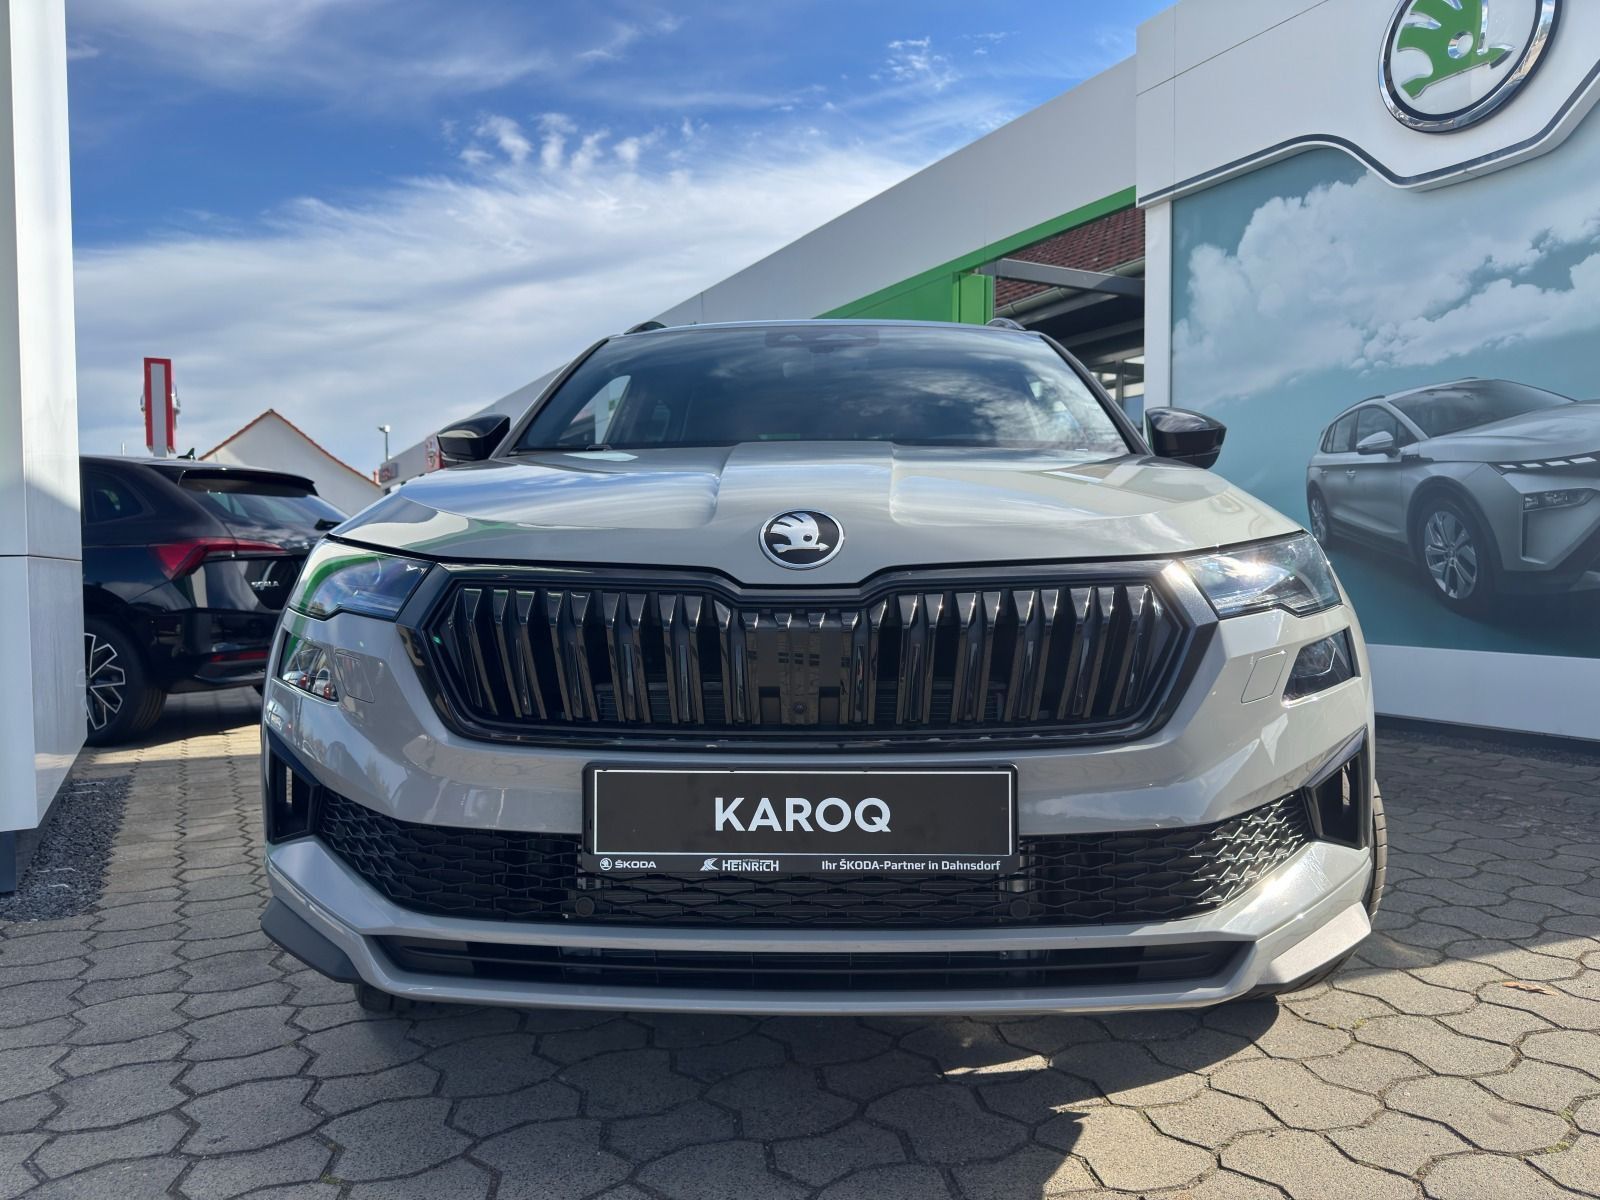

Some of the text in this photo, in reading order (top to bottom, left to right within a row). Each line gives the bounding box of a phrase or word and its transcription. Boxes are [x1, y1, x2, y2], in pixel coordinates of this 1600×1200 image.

[714, 796, 892, 833] KAROQ
[614, 859, 657, 869] ŠKODA
[821, 858, 1001, 871] Ihr ŠKODA-Partner in Dahnsdorf
